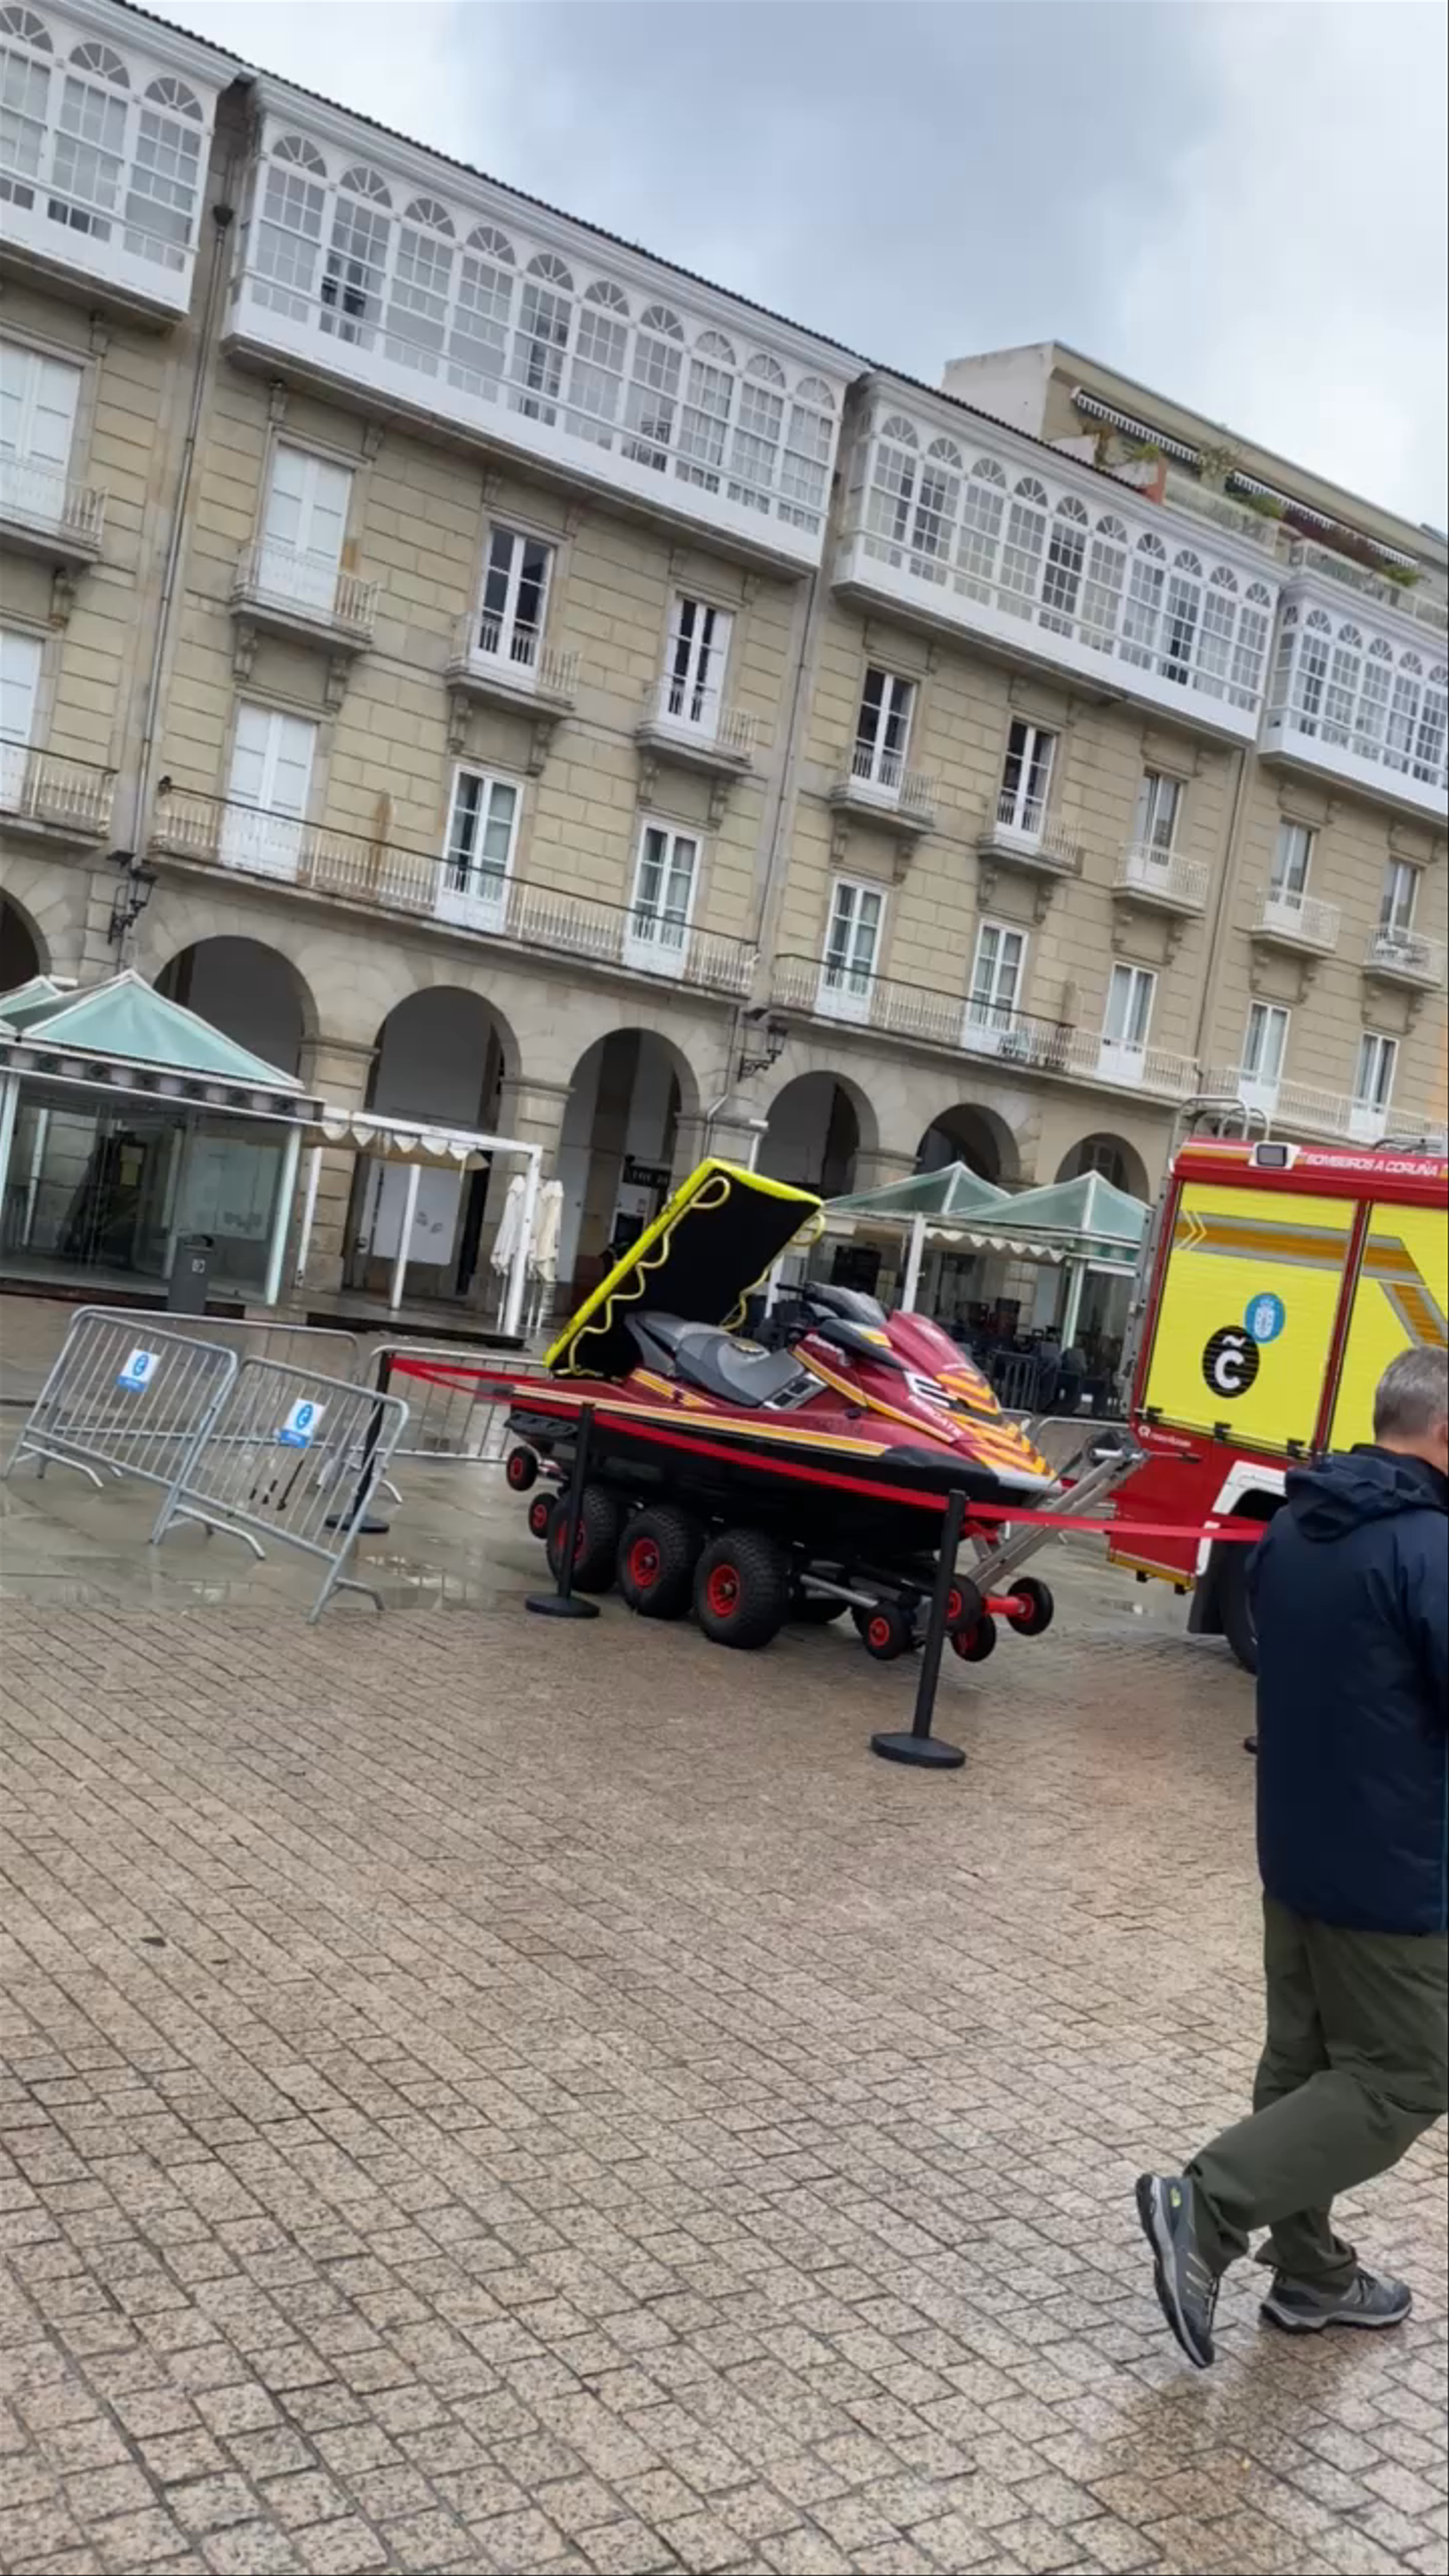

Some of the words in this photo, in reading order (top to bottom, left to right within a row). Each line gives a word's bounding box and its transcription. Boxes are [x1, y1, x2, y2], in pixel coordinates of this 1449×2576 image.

[1306, 1153, 1375, 1170] BOMBEIROS
[1374, 1159, 1384, 1171] A
[1385, 1159, 1438, 1177] CORUÑA
